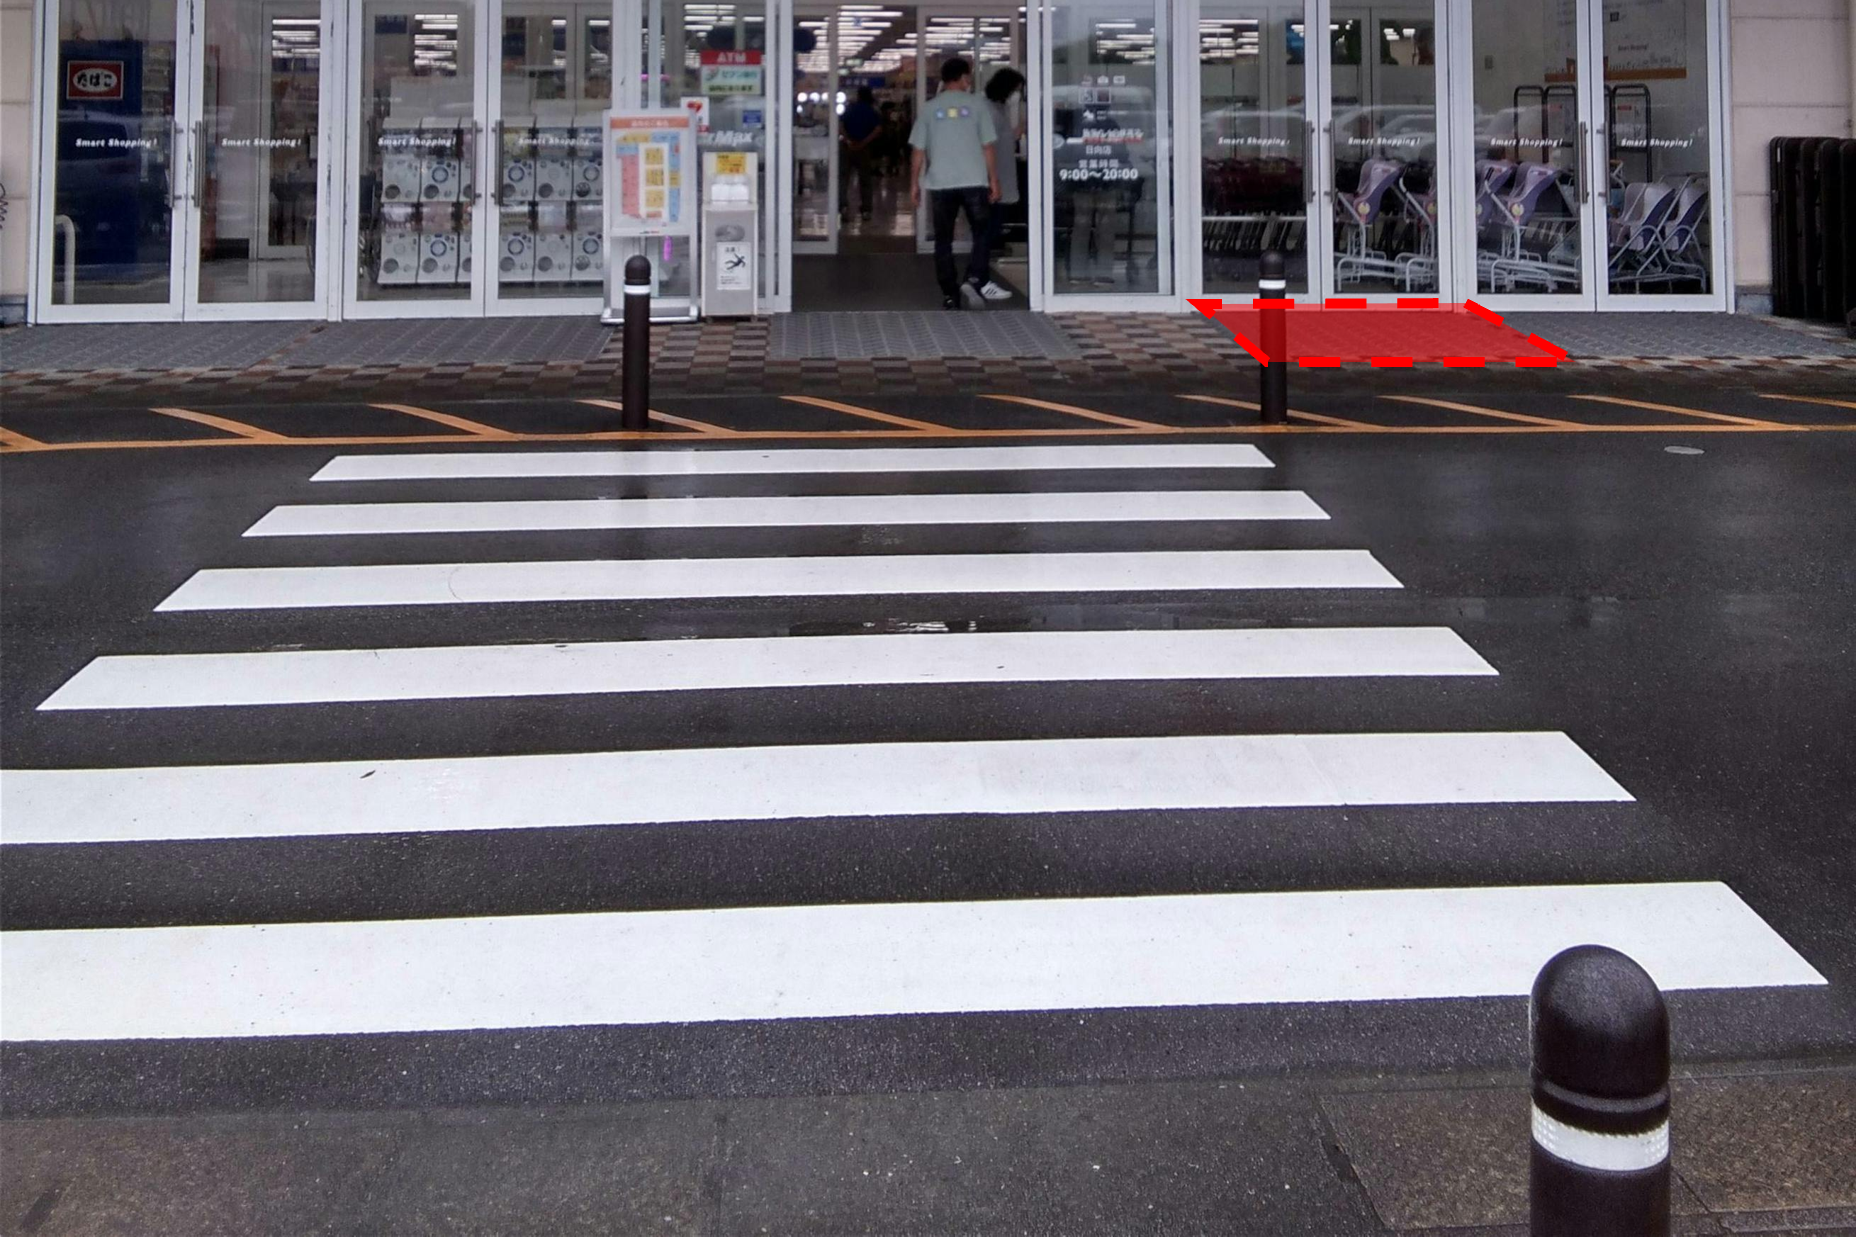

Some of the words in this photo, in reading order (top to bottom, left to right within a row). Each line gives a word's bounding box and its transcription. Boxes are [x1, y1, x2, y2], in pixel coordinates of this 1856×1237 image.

[717, 51, 747, 62] ATM
[77, 72, 112, 88] たばこ
[75, 137, 106, 148] Smart
[222, 137, 251, 148] Smart
[377, 136, 408, 147] Smart
[1218, 136, 1244, 146] Smart
[1348, 136, 1375, 146] Smart
[1490, 137, 1517, 147] Smart
[1621, 137, 1648, 147] Smart
[1085, 145, 1113, 155] 日向店
[1078, 159, 1120, 169] 営業時間
